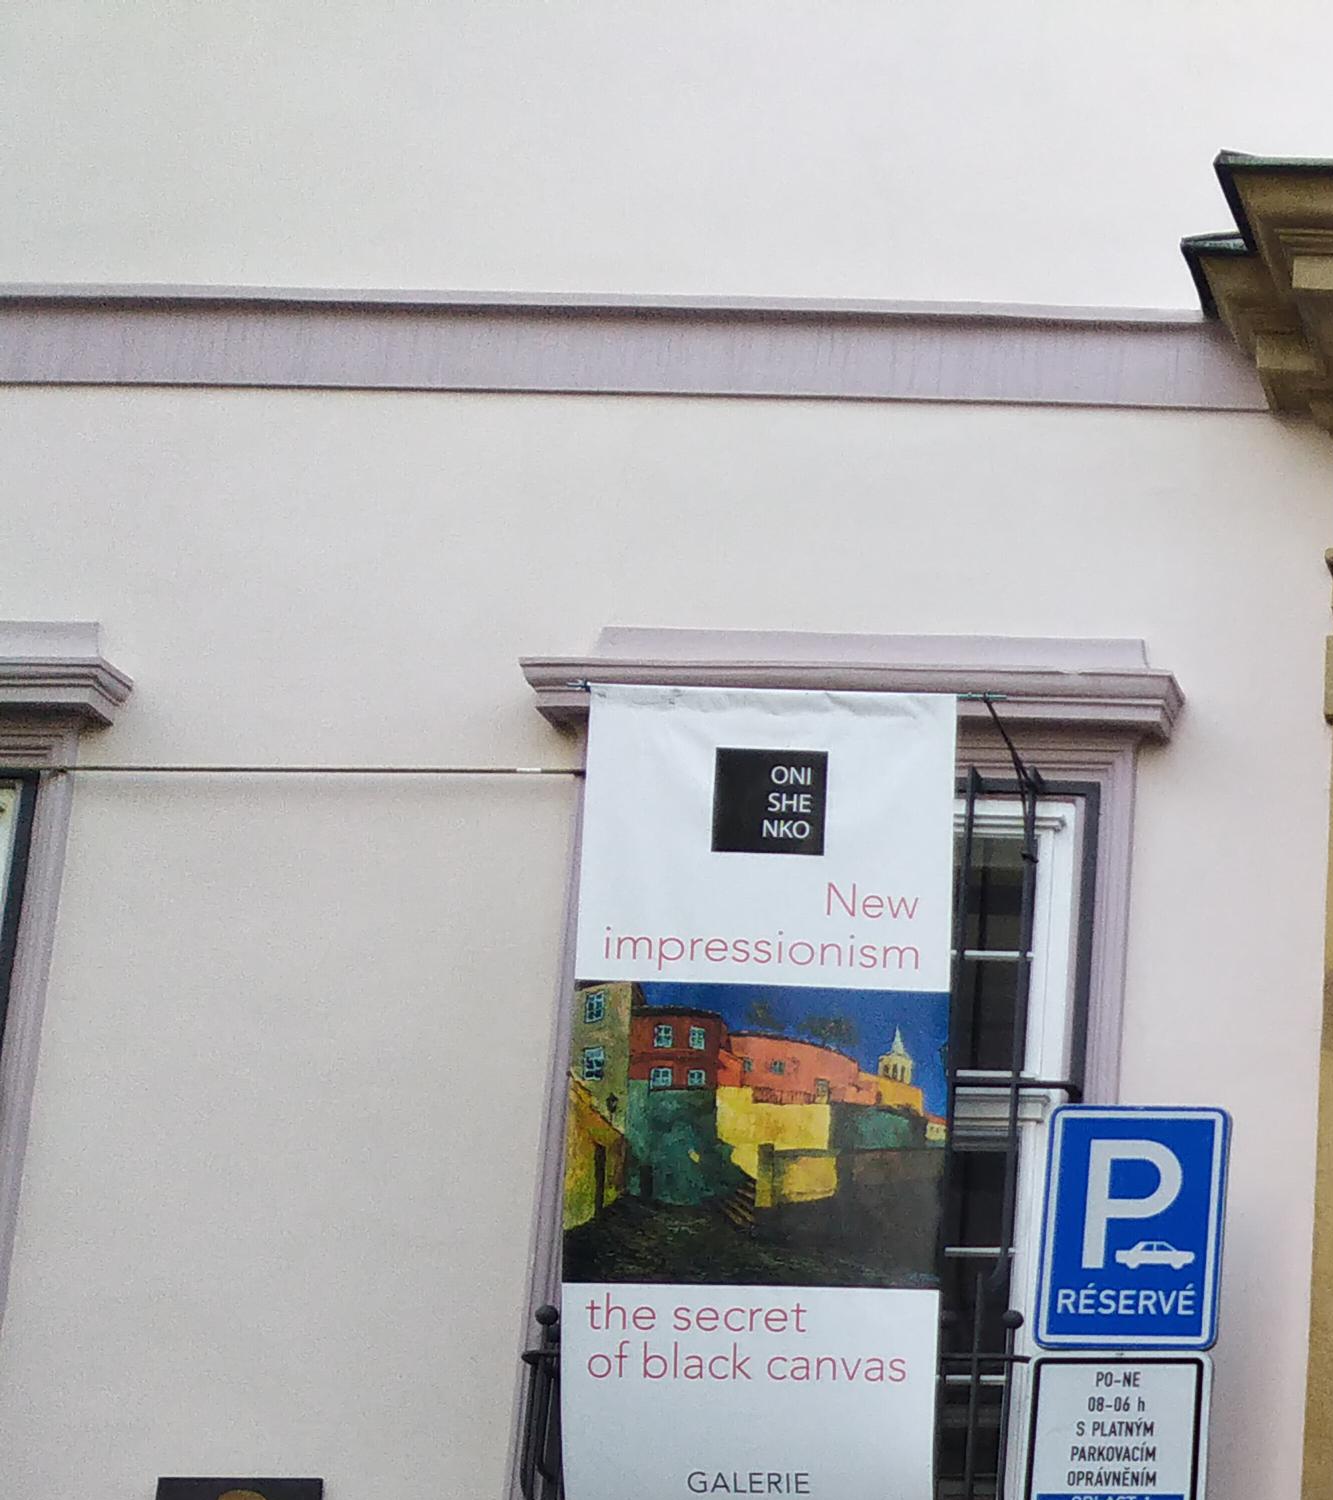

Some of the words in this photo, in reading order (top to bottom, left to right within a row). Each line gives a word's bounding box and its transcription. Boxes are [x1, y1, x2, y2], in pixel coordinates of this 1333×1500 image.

[770, 766, 812, 786] ONI
[767, 793, 812, 813] SHE
[762, 820, 811, 840] NKO
[825, 883, 919, 920] New
[603, 926, 921, 972] impressionism
[1082, 1138, 1183, 1269] P
[1056, 1283, 1196, 1316] RÉSERVÉ
[585, 1292, 657, 1331] the
[672, 1301, 808, 1333] secret
[586, 1340, 629, 1380] of
[643, 1342, 752, 1382] black
[767, 1352, 908, 1383] canvas
[1095, 1371, 1141, 1388] PO-NE
[1087, 1396, 1130, 1412] 08-06
[1137, 1397, 1145, 1412] h
[1076, 1421, 1085, 1437] S
[1091, 1417, 1154, 1437] PLATNÝM
[1070, 1442, 1157, 1462] PARKOVACÍM
[686, 1471, 811, 1496] GALERIE
[1067, 1466, 1157, 1487] OPRÁVNĚNÍM
